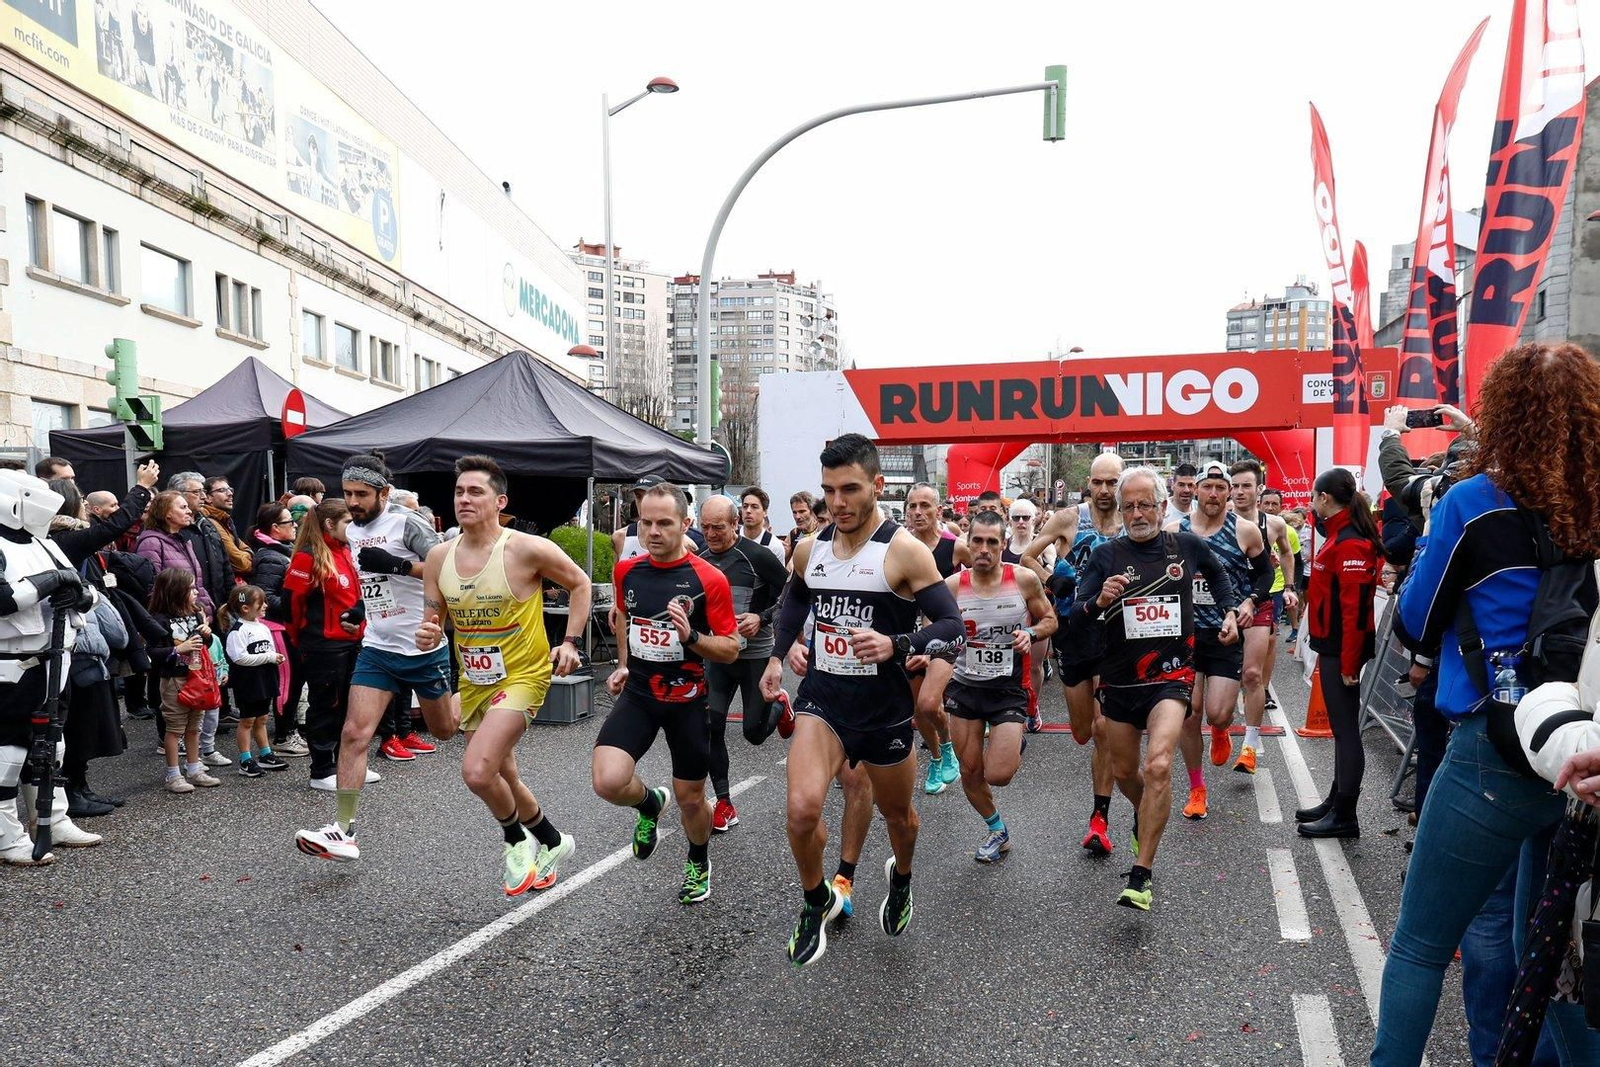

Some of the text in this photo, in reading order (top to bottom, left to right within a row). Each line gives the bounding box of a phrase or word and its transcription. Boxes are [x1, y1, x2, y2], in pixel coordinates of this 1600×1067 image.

[14, 27, 70, 68] mcfit.com
[219, 19, 233, 42] DE
[235, 31, 272, 66] GALICIA
[187, 120, 198, 134] DE
[519, 276, 580, 345] MERCADONA
[957, 482, 981, 490] Sports
[1283, 477, 1310, 485] Sports
[815, 595, 874, 621] delikia
[1135, 605, 1170, 622] 504
[844, 619, 863, 628] fresh
[640, 627, 671, 647] 552
[824, 635, 852, 656] 60
[463, 655, 492, 670] 540
[975, 650, 1003, 664] 138
